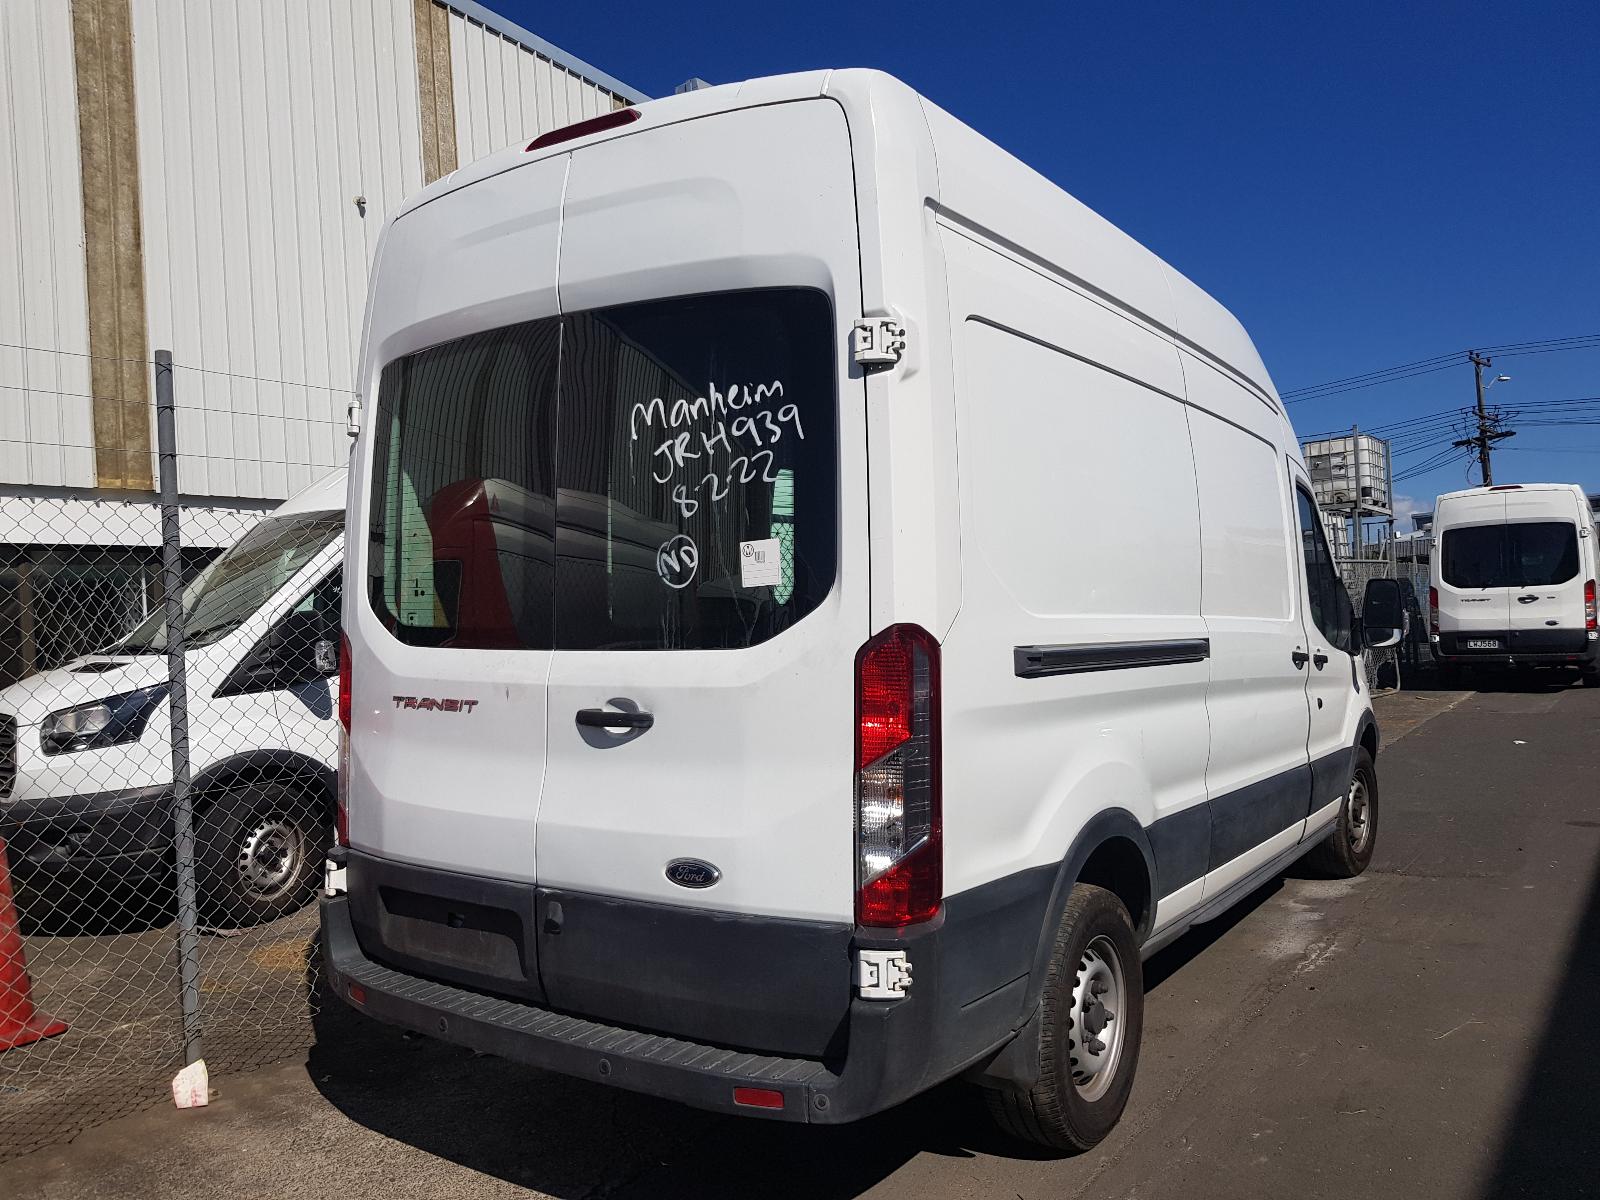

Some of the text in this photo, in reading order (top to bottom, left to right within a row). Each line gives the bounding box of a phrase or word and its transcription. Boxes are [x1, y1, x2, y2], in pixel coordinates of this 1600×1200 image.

[631, 379, 784, 440] Manheim
[392, 695, 479, 713] TRANSIT
[676, 865, 705, 882] Ford
